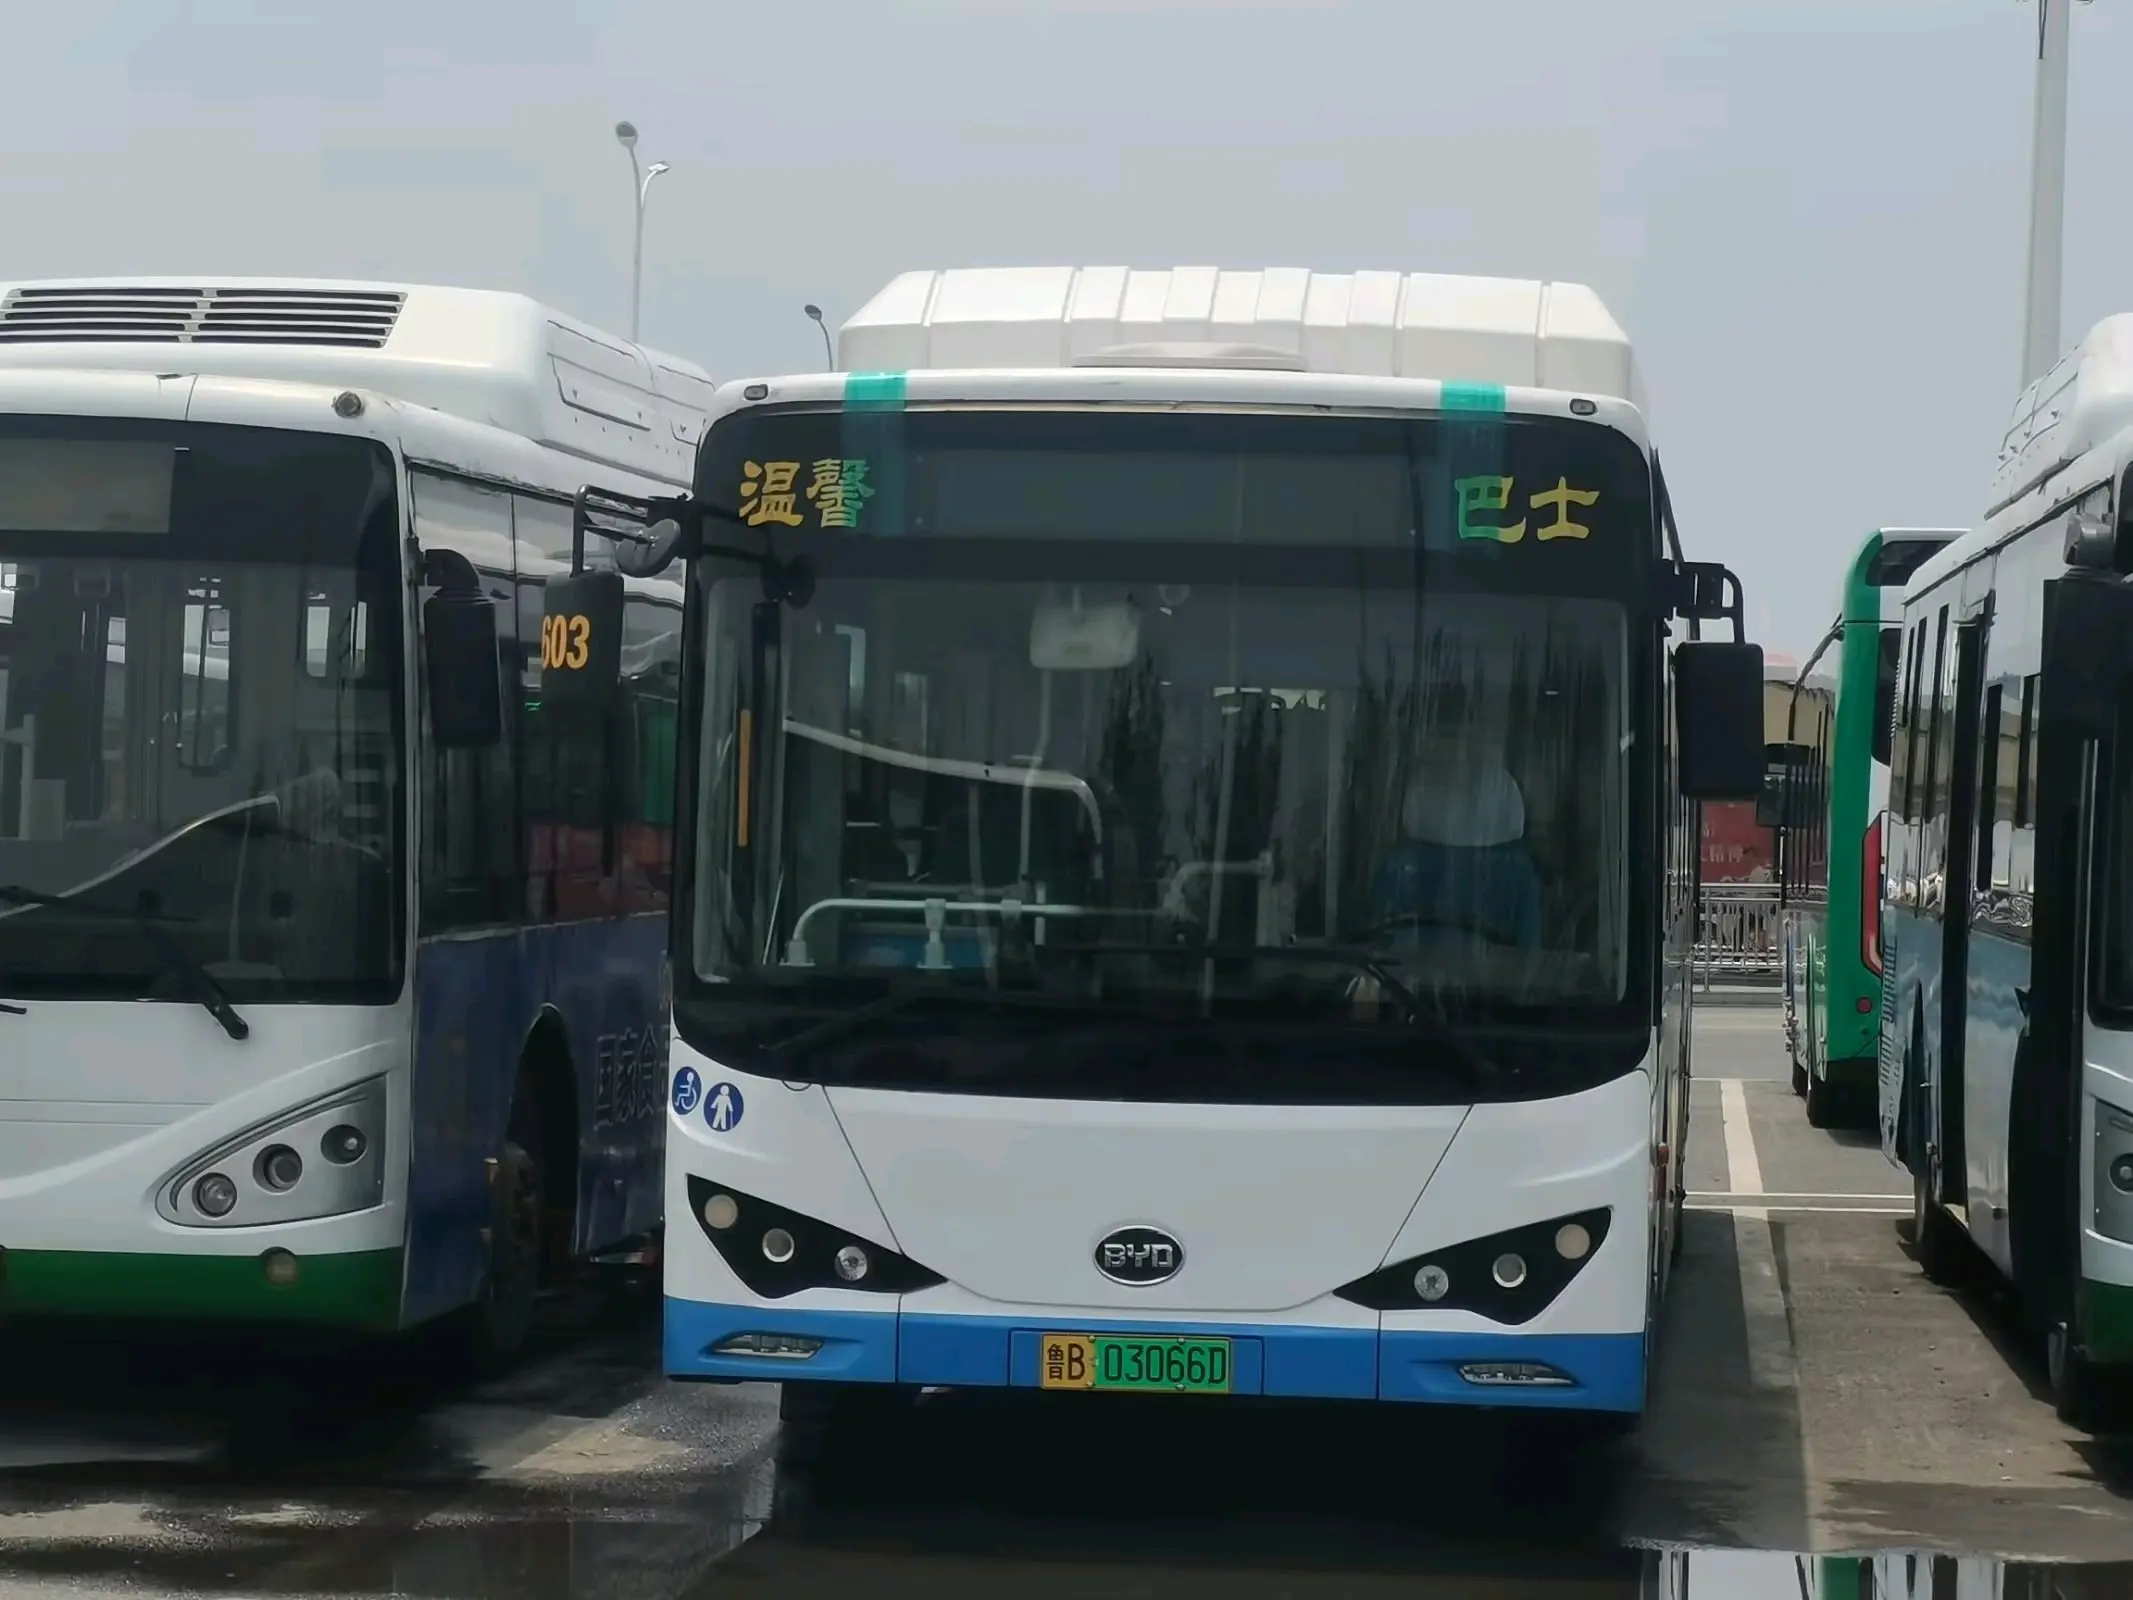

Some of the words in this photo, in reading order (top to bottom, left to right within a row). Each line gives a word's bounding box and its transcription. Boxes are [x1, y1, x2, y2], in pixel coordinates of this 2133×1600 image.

[738, 458, 876, 528] 温馨
[1454, 475, 1600, 543] 巴士
[541, 614, 590, 669] 603
[1104, 1244, 1173, 1267] BYD
